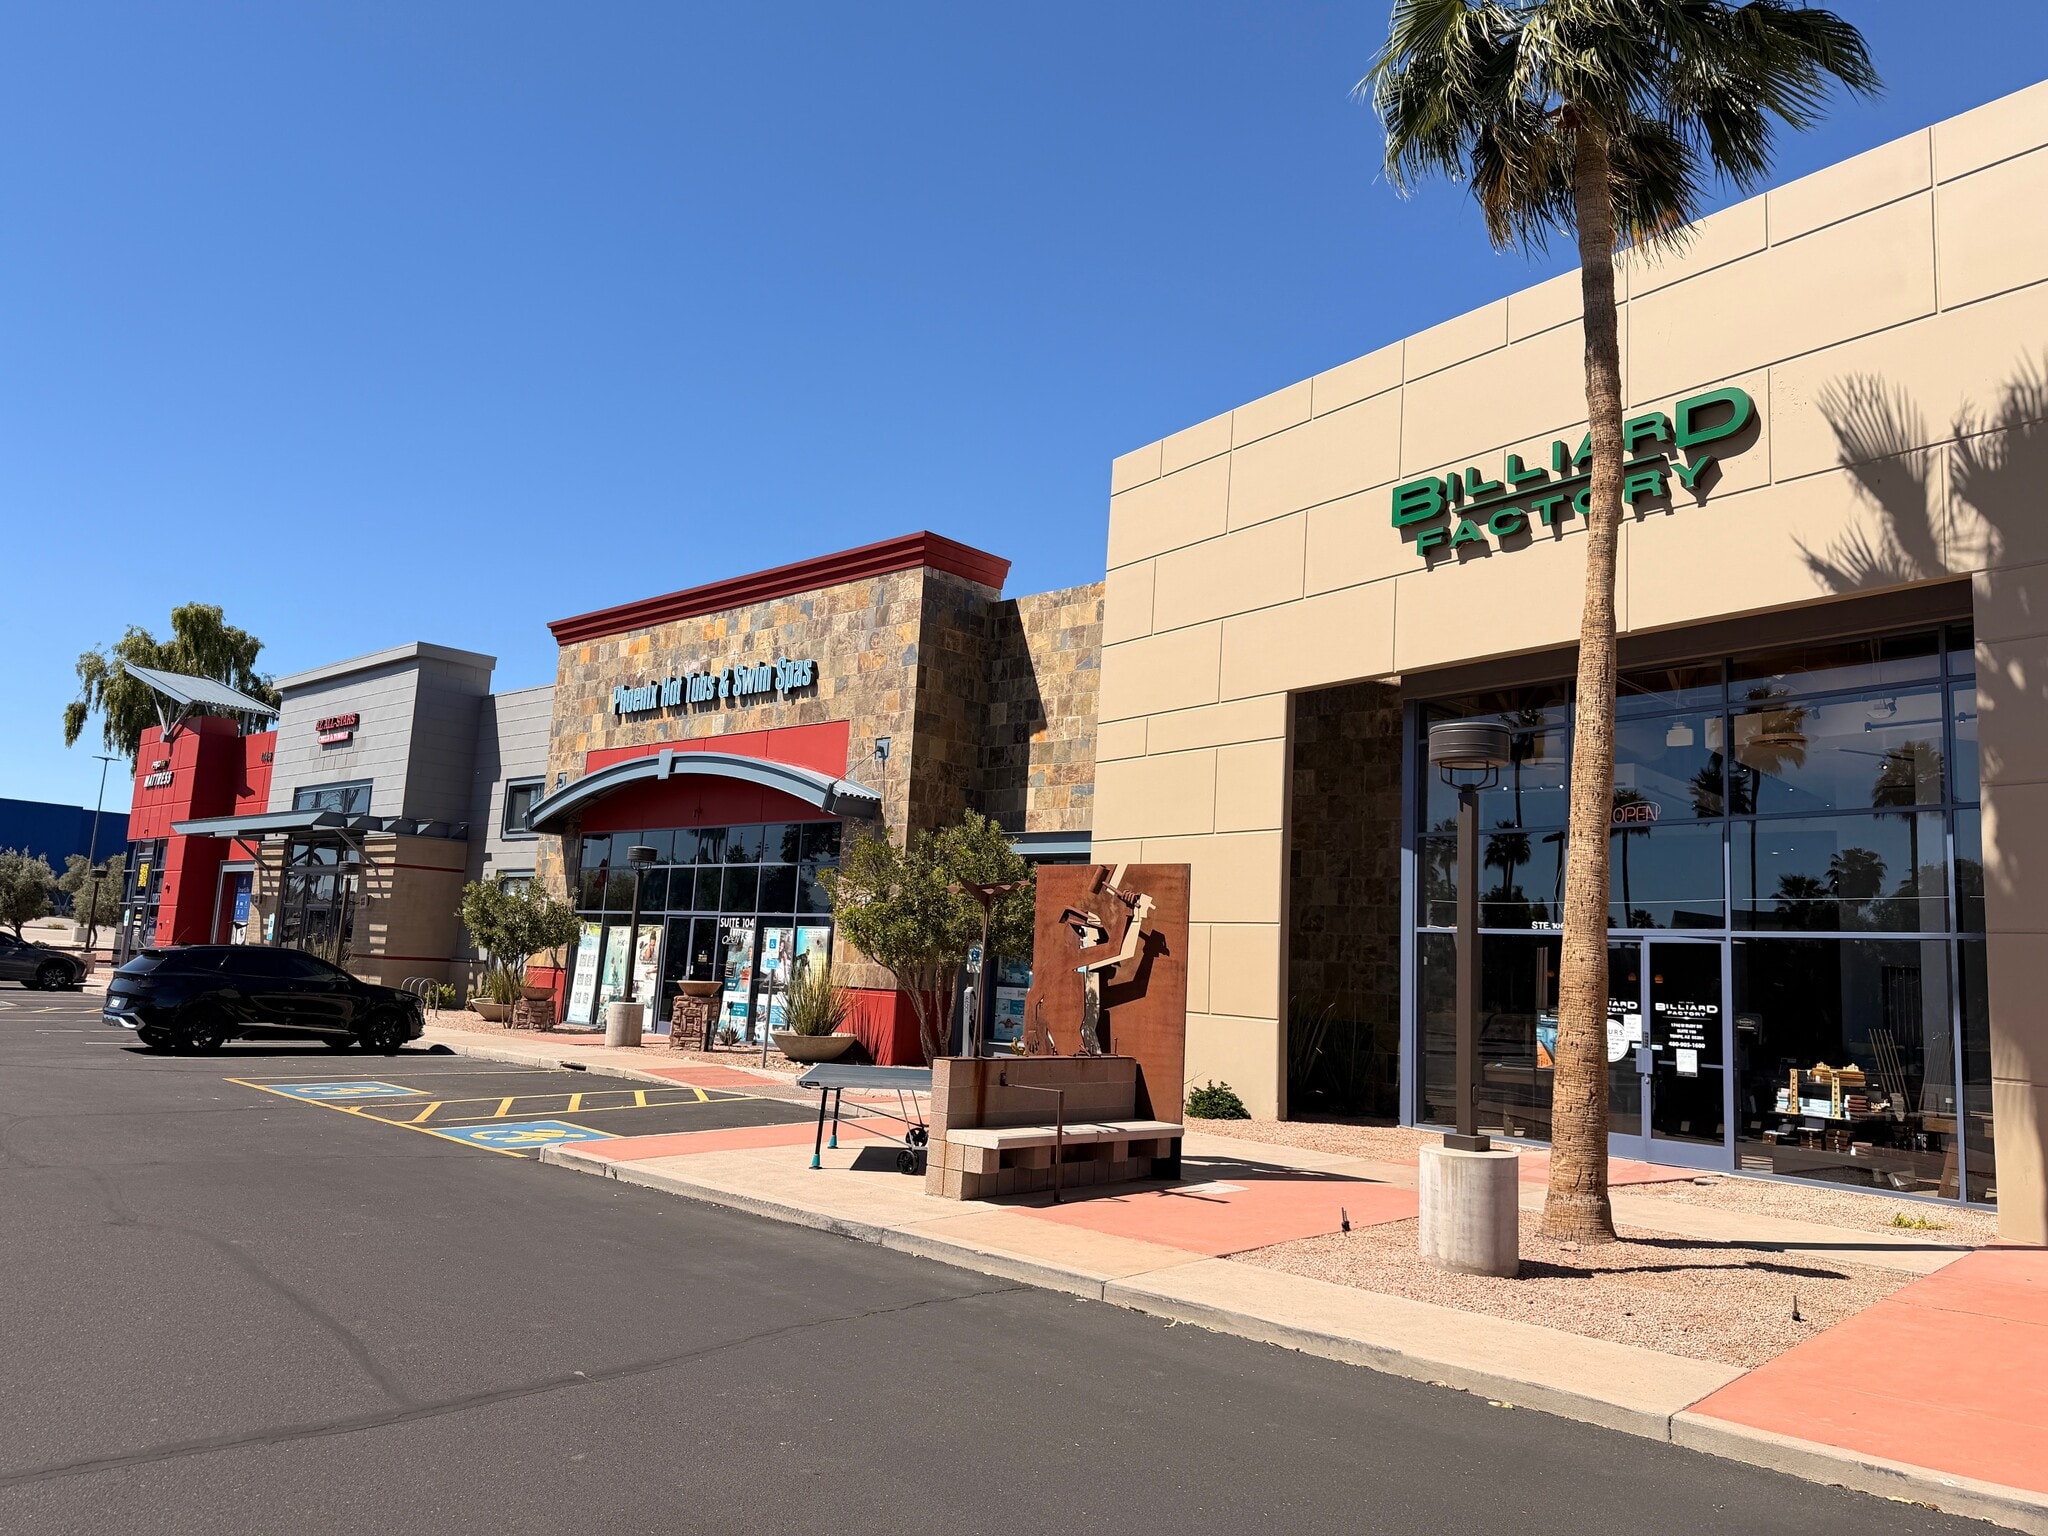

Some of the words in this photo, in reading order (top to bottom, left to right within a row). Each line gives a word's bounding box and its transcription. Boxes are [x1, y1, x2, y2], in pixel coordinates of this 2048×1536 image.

[612, 681, 657, 715] Phoenix
[660, 676, 682, 707] Hot
[685, 672, 715, 702] Tubs
[718, 667, 730, 698] &
[733, 661, 771, 697] Swim
[775, 656, 814, 694] Spas
[143, 771, 173, 788] MATTRESS
[1613, 805, 1659, 823] OPEN
[720, 917, 740, 928] SUITE
[742, 917, 755, 928] 104
[1531, 921, 1551, 930] STE.
[1655, 1003, 1718, 1013] BILLIARD
